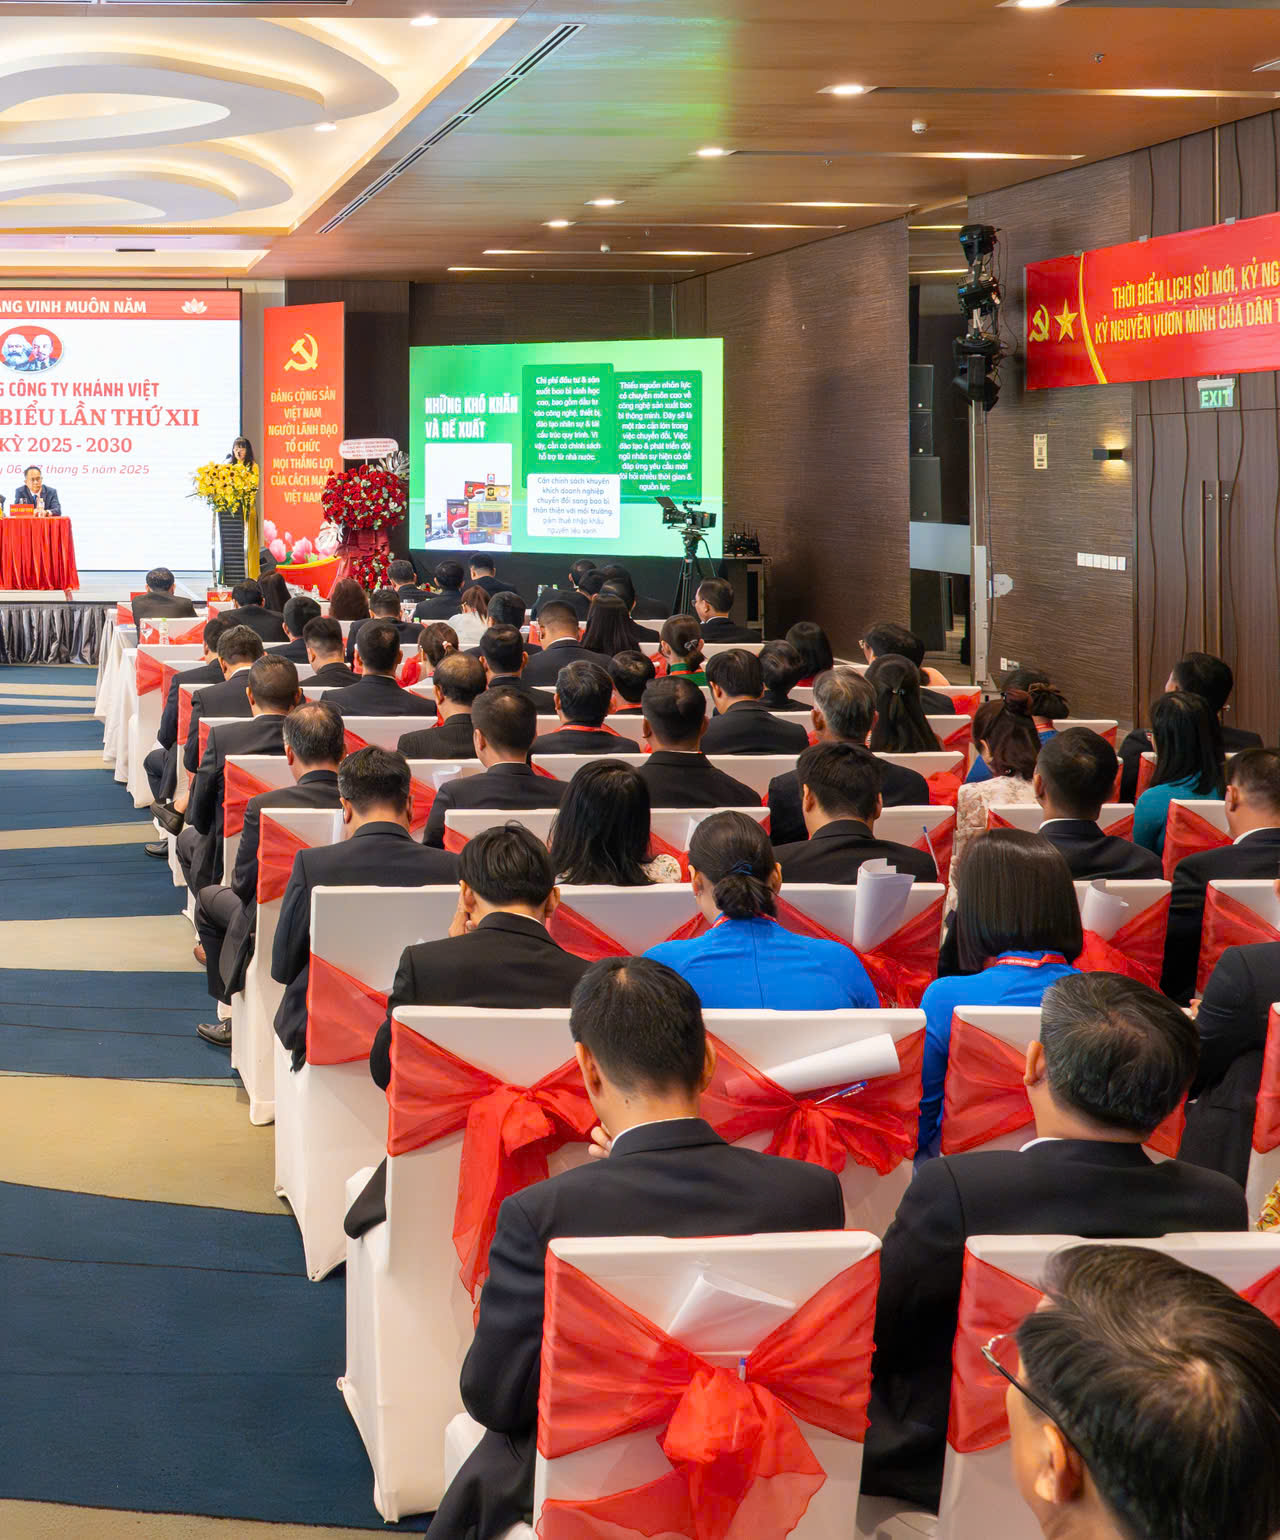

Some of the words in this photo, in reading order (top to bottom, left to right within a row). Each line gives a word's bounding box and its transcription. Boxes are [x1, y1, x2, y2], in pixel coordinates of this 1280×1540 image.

[1112, 281, 1135, 309] THỜI
[1138, 272, 1164, 306] ĐIỂM
[1167, 276, 1192, 306] LỊCH
[1194, 265, 1209, 297] SỬ
[1212, 264, 1238, 295] MỚI,
[1242, 256, 1258, 290] KỶ
[26, 300, 61, 312] VINH
[66, 297, 109, 313] MUÔN
[114, 297, 146, 313] NĂM
[1095, 315, 1108, 344] KỶ
[1110, 313, 1151, 342] NGUYÊN
[1186, 305, 1216, 333] MÌNH
[1219, 298, 1243, 329] CỦA
[1246, 296, 1272, 326] DÂN
[9, 379, 46, 396] CÔNG
[50, 382, 68, 396] TY
[73, 379, 123, 396] KHÁNH
[128, 379, 160, 400] VIỆT
[271, 388, 293, 402] ĐẢNG
[295, 388, 318, 404] CỘNG
[319, 386, 336, 400] SẢN
[425, 394, 462, 414] NHỮNG
[464, 393, 486, 414] KHÓ
[488, 392, 518, 414] KHĂN
[1202, 390, 1230, 406] EXIT
[59, 401, 106, 426] LẦN
[111, 405, 163, 426] THỨ
[165, 409, 200, 426] XII
[284, 405, 302, 421] VIỆT
[303, 408, 321, 418] NAM
[269, 423, 296, 436] NGƯỜI
[297, 422, 319, 435] LÃNH
[320, 424, 338, 438] ĐẠO
[425, 418, 439, 438] VÀ
[458, 418, 486, 438] XUẤT
[28, 438, 72, 452] 2025
[86, 438, 132, 452] 2030
[285, 436, 296, 452] TỔ
[298, 438, 320, 452] CHỨC
[82, 465, 88, 474] 5
[120, 465, 149, 474] 2025
[273, 458, 288, 472] MỌI
[290, 453, 318, 469] THẮNG
[320, 457, 333, 472] LỢI
[271, 471, 287, 486] CỦA
[288, 472, 309, 486] CÁCH
[284, 489, 302, 505] VIỆT
[303, 492, 322, 503] NAM
